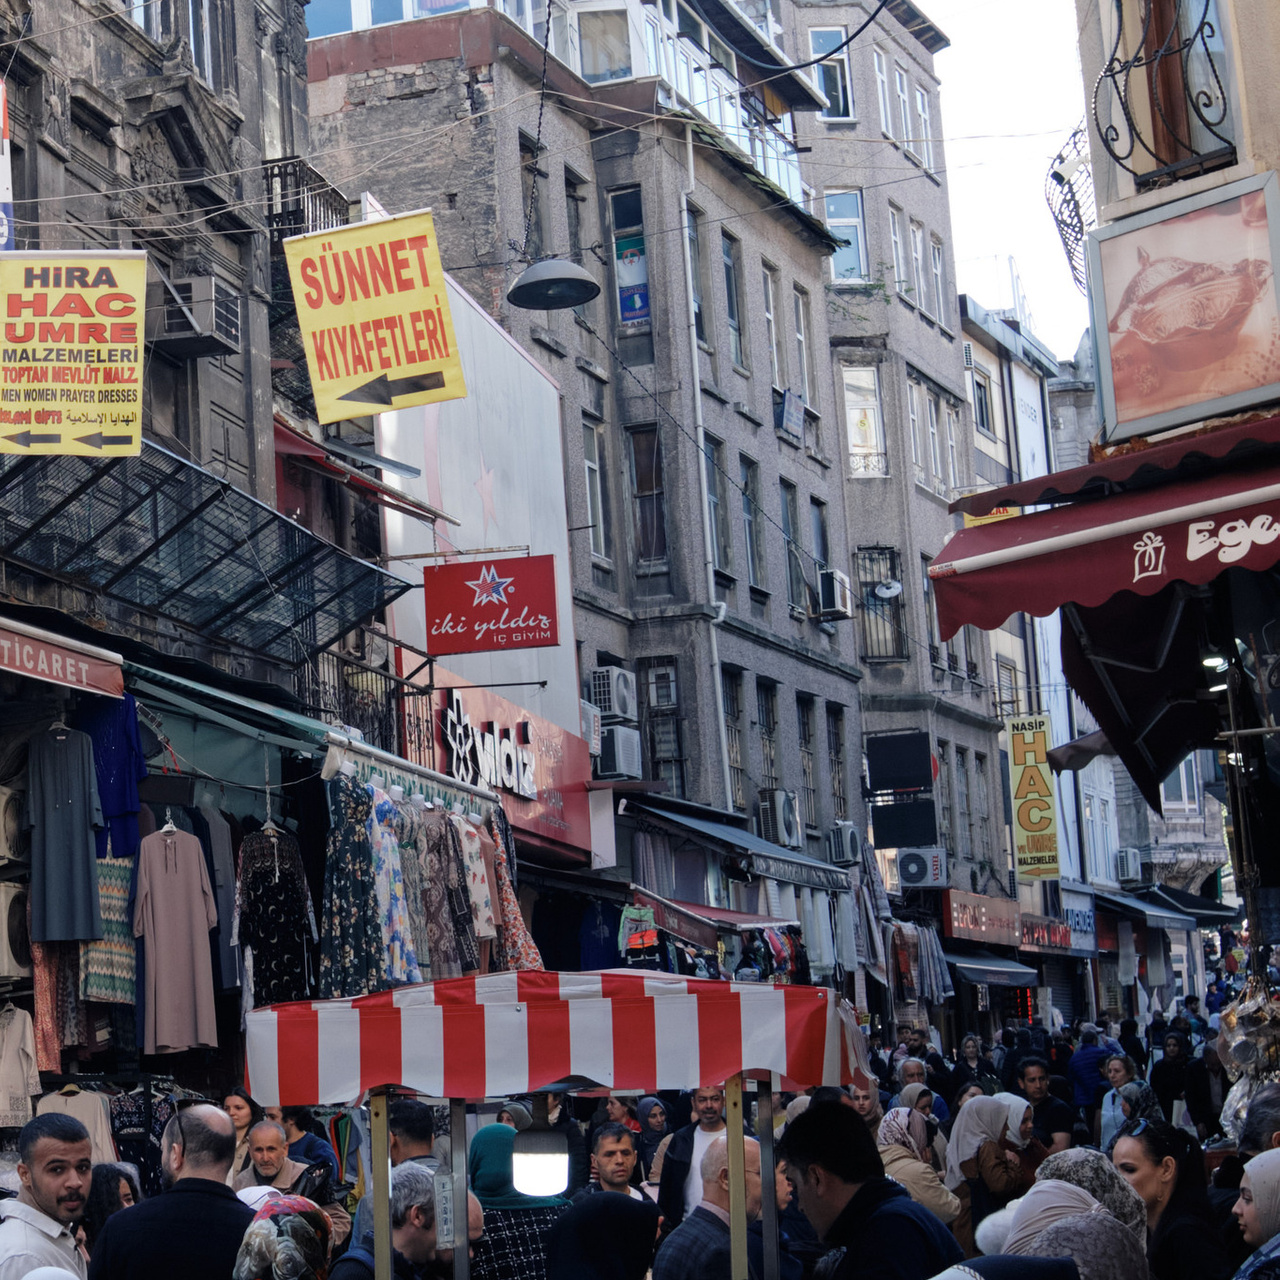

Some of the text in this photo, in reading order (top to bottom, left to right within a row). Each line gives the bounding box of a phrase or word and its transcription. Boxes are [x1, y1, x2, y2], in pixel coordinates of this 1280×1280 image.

[300, 234, 431, 310] SÜNNET
[7, 292, 137, 318] HAC
[4, 322, 138, 344] UMRE
[311, 293, 451, 382] KIYAFETLERİ
[2, 345, 139, 363] MALZEMELERİ
[1, 365, 49, 384] TOPTAN
[51, 363, 101, 385] MEVLÜT
[1, 388, 138, 404] MEN WOMEN PRAYER DRESSES
[431, 603, 553, 643] iki yıldız
[512, 627, 552, 643] GİYİM
[0, 636, 90, 687] TİCARET
[1011, 718, 1046, 733] NASİP
[1026, 833, 1057, 855] UMRE
[932, 854, 940, 882] VESTEL
[1018, 853, 1058, 867] MALZEMELERİ
